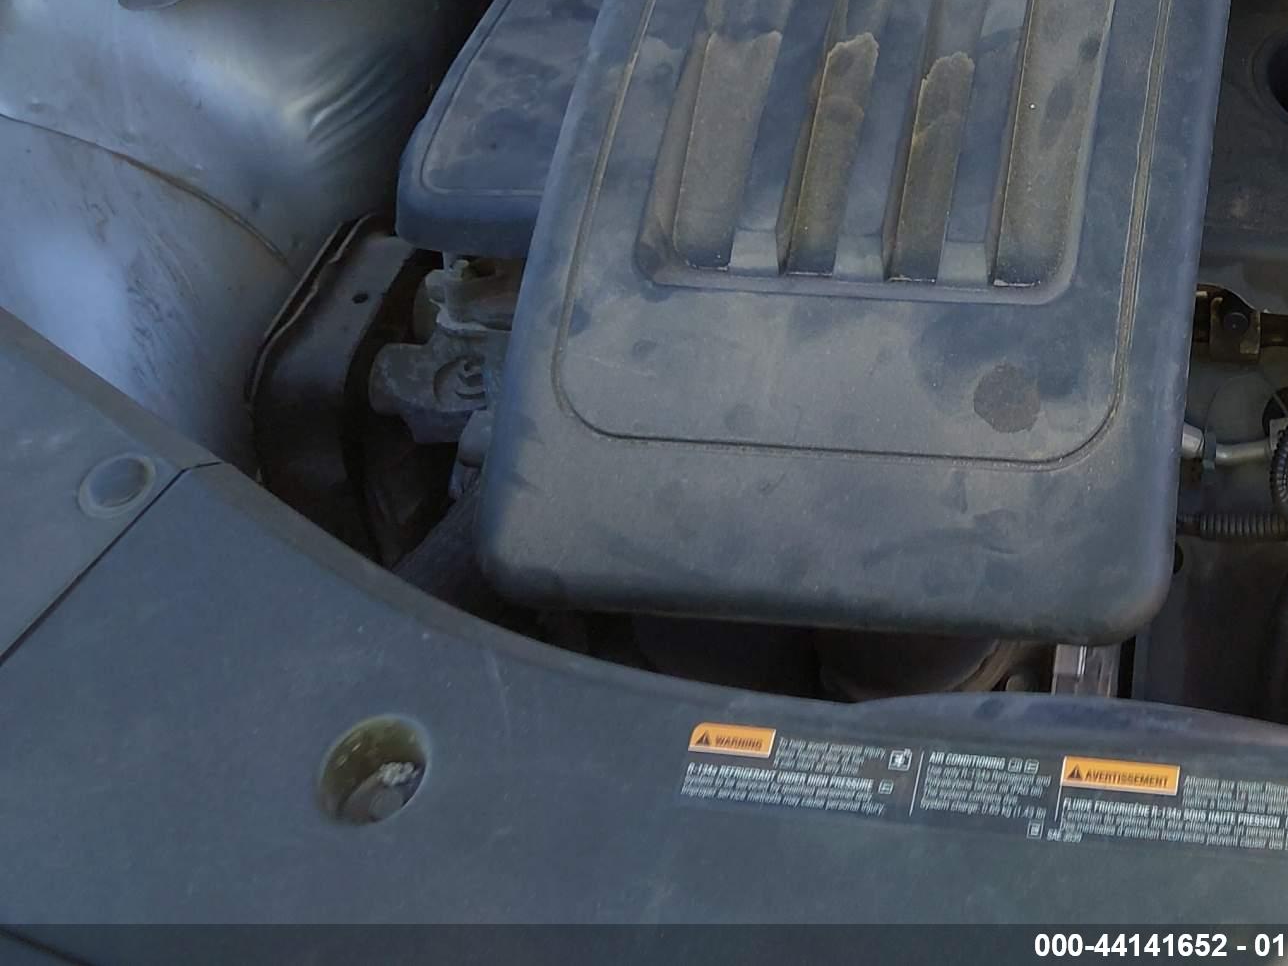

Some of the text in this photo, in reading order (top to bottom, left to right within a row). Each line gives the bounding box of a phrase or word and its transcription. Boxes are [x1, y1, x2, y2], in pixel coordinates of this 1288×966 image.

[715, 735, 763, 751] WARNING
[929, 752, 1006, 770] AIR CONDITIONING
[718, 765, 776, 782] REFRIGERANT
[777, 770, 807, 784] UNDER
[807, 772, 829, 786] HIGH
[829, 774, 875, 790] PRESSURE
[1085, 769, 1169, 788] AVERTISSEMENT
[1183, 808, 1208, 822] SOUS
[1207, 810, 1237, 825] HAUTE
[1237, 812, 1281, 829] PRESSION
